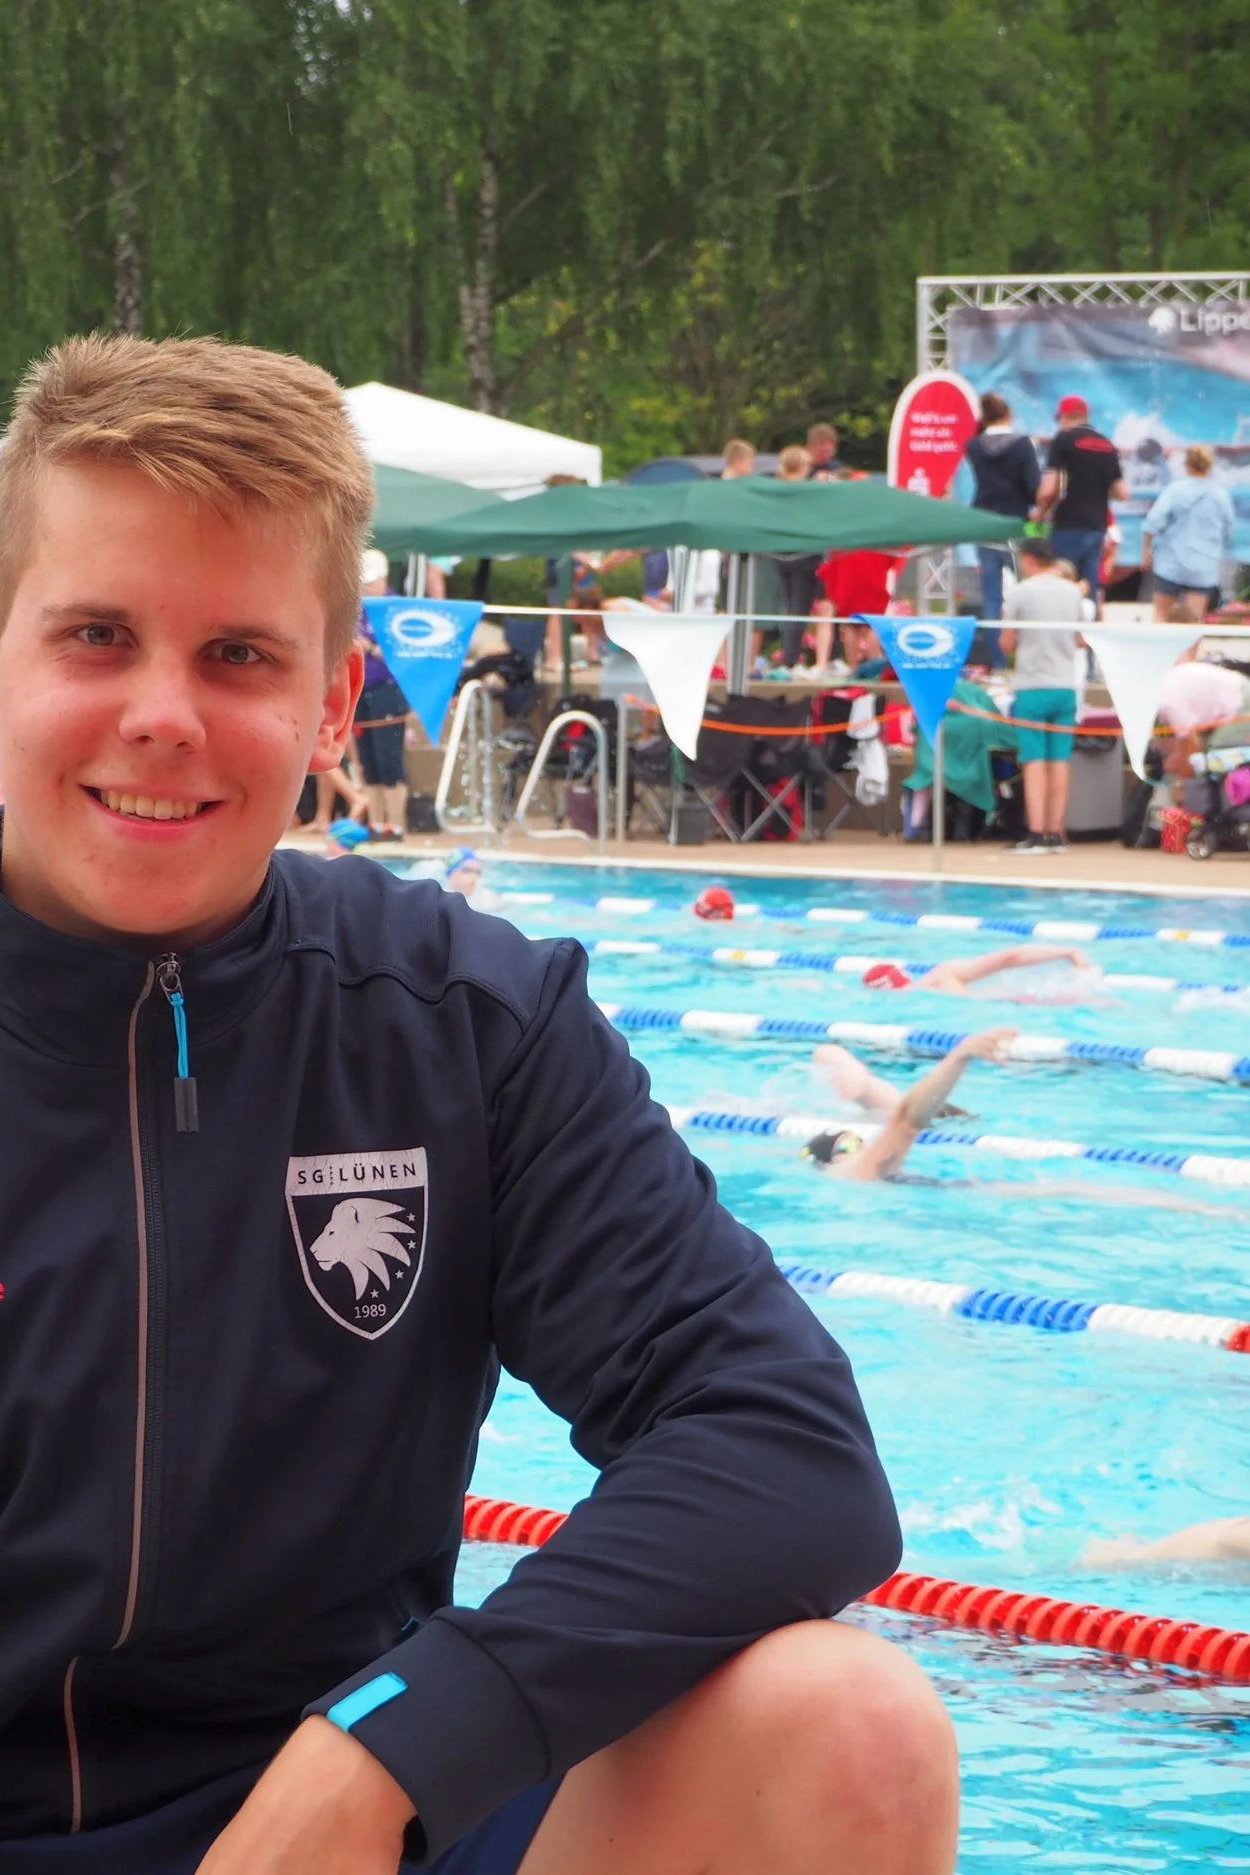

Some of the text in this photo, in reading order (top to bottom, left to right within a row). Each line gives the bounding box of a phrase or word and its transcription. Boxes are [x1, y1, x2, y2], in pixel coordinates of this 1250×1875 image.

[298, 1163, 417, 1185] SG LÜNEN
[353, 1303, 388, 1319] 1989
